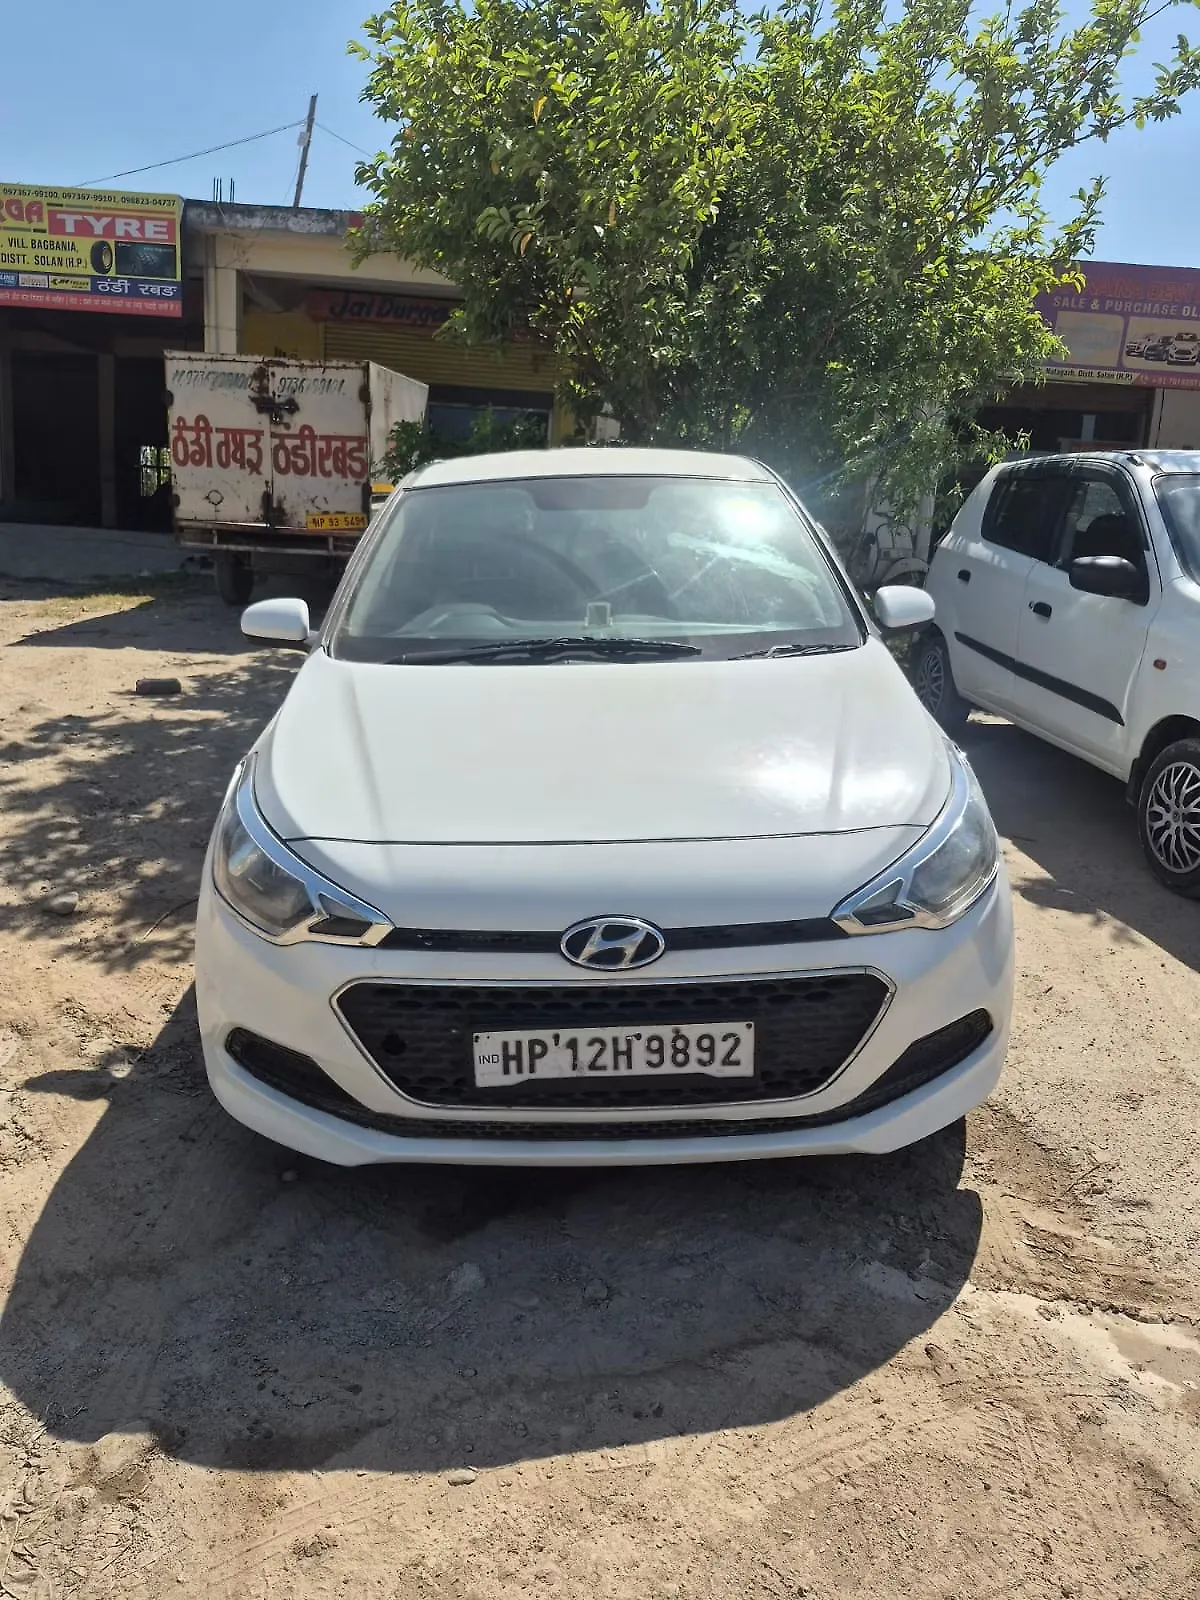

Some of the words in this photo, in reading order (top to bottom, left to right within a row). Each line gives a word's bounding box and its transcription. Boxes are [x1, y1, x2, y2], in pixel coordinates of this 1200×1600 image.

[56, 213, 169, 240] TYRE
[8, 237, 28, 249] VILL.
[31, 240, 79, 253] BAGBANIA,
[1, 253, 30, 265] DISTT.
[34, 254, 63, 267] SOLAN
[65, 258, 88, 270] (H.P.)
[97, 279, 132, 294] ठंडी
[1054, 296, 1088, 309] SALE
[1091, 299, 1099, 310] &
[1105, 300, 1177, 316] PURCHASE
[1182, 305, 1200, 318] OL
[479, 1054, 499, 1065] IND
